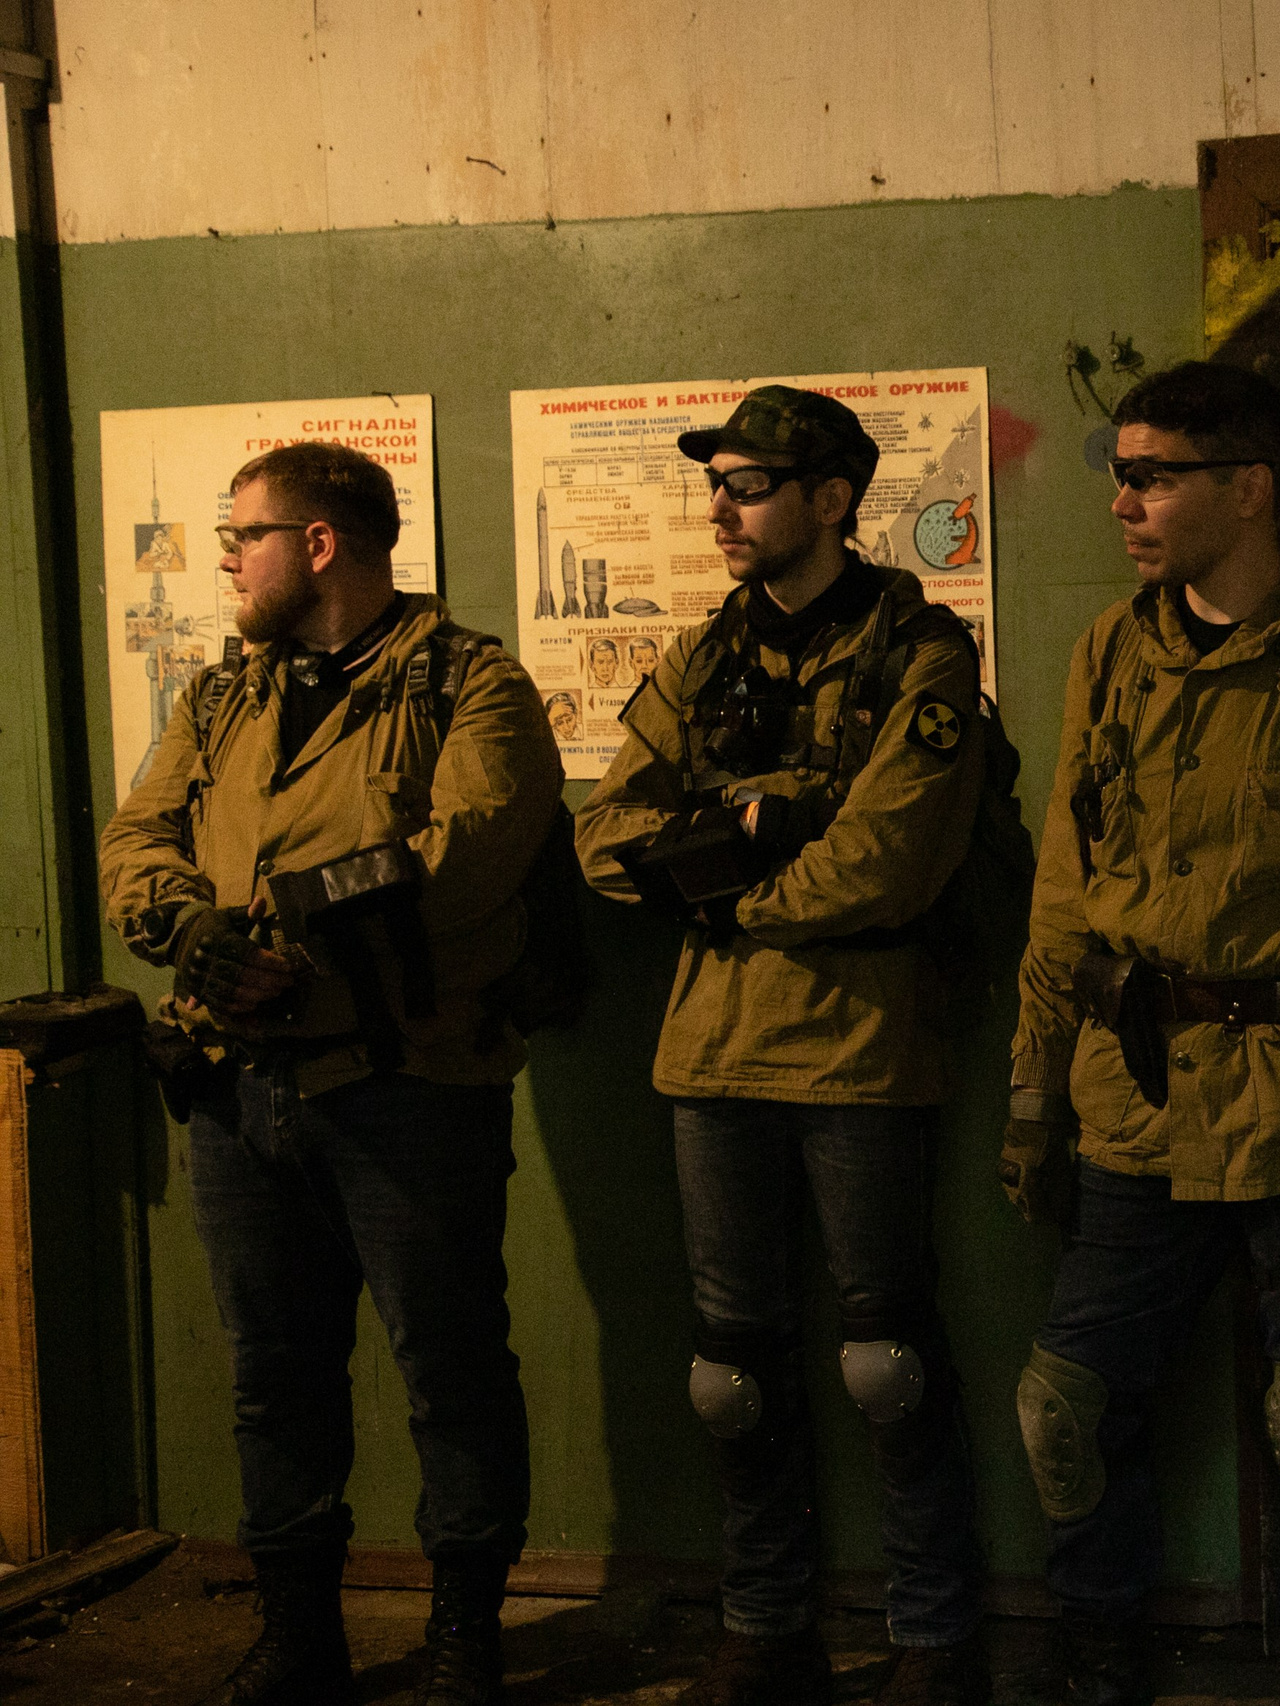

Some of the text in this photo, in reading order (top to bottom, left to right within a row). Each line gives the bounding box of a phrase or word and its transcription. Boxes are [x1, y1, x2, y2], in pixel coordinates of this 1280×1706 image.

[540, 396, 648, 415] ХИМИЧЕСКОЕ
[657, 396, 668, 407] И
[889, 381, 969, 396] ОРУЖИЕ
[302, 418, 417, 432] СИГНАЛЫ
[566, 487, 617, 496] СРЕДСТВА
[662, 490, 709, 498] ПРИМЕНЕ
[566, 495, 631, 503] ПРИМЕНЕНИЯ
[568, 626, 637, 636] ПРИЗНАКИ
[540, 637, 573, 645] ИПРИТОМ
